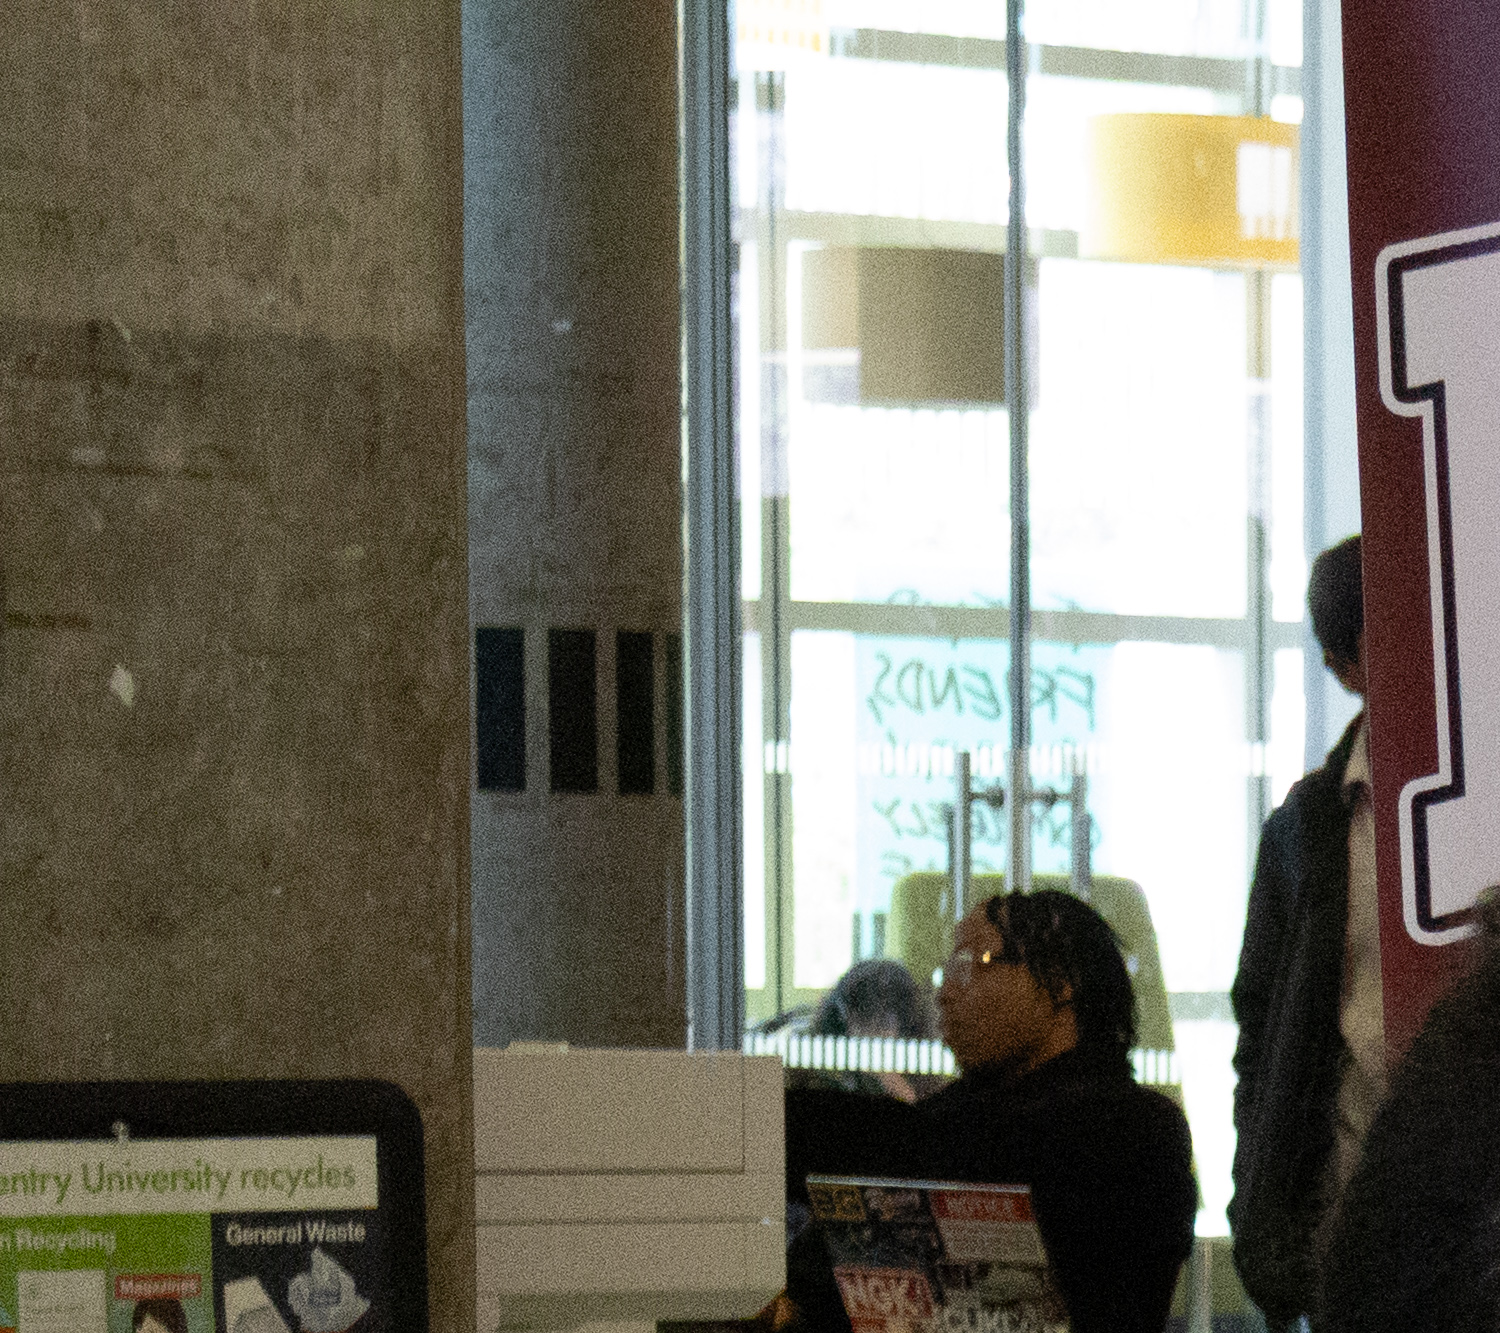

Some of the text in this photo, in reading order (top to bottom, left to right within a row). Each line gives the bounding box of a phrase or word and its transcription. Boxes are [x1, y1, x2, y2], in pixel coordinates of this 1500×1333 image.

[82, 1160, 231, 1200] University
[241, 1156, 356, 1198] recycles
[226, 1220, 367, 1246] General Waste
